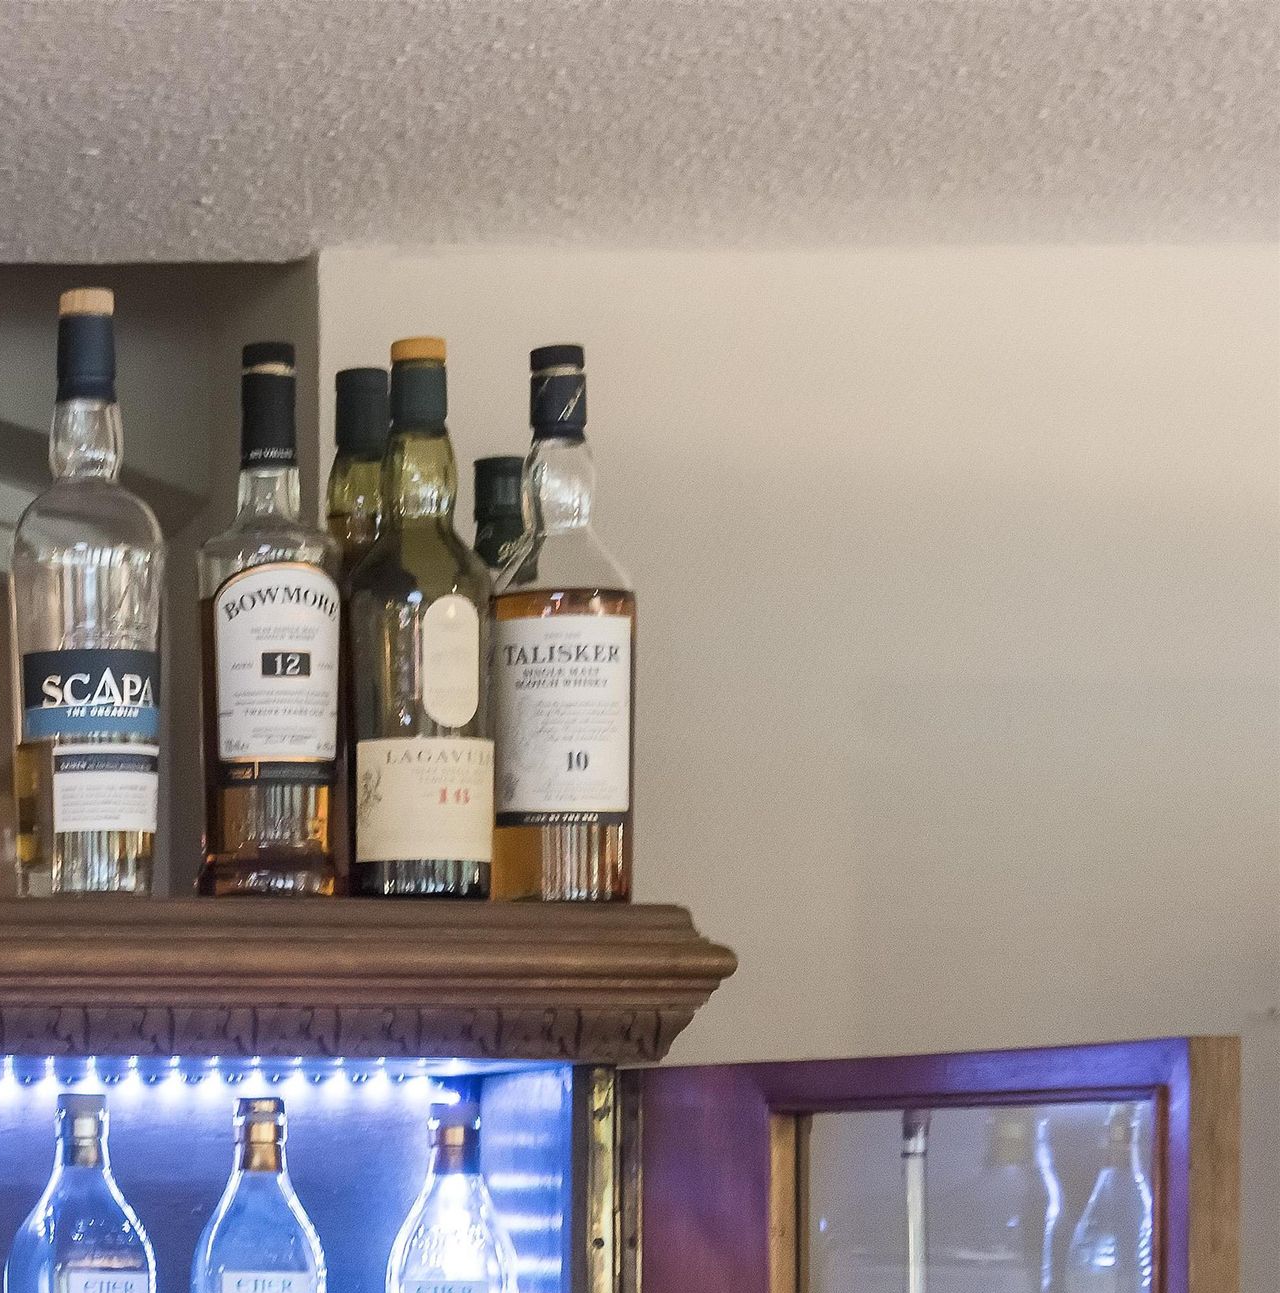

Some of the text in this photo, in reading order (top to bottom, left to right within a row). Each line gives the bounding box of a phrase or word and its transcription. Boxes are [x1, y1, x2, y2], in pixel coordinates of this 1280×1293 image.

[222, 587, 340, 622] BOWMORE
[274, 654, 301, 676] 12
[504, 643, 621, 667] TALISKER
[42, 667, 155, 708] SCAPA
[67, 707, 86, 718] THE
[567, 751, 589, 771] 10
